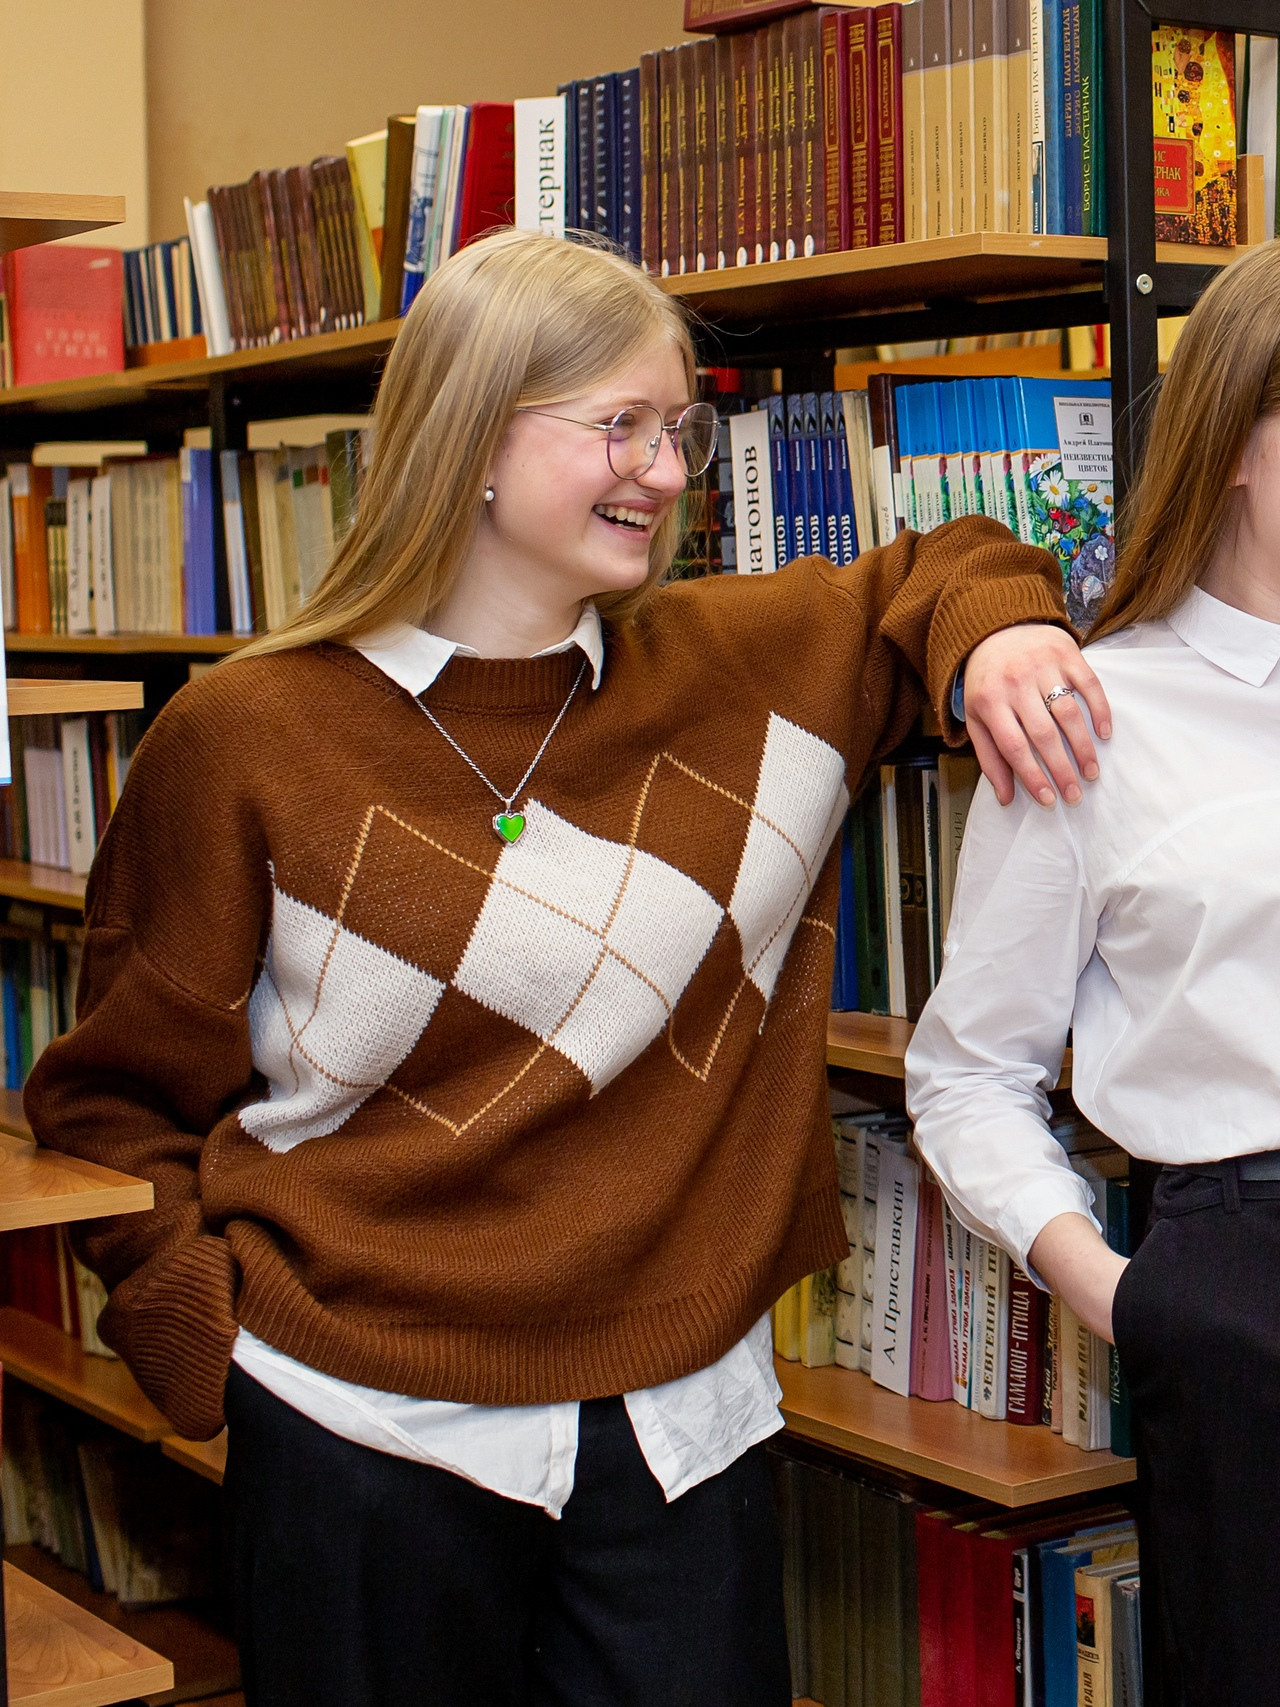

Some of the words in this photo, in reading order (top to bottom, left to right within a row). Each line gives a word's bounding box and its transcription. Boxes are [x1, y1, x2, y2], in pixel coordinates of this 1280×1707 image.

[1030, 5, 1040, 93] ПАСТЕРНАК
[1062, 6, 1071, 87] ПАСТЕРНАК
[1071, 3, 1081, 84] ПАСТЕРНАК
[1081, 75, 1091, 161] ПАСТЕРНАК
[538, 118, 562, 238] тернак
[1083, 163, 1091, 212] БОРИС
[882, 1179, 905, 1366] А.Приставкин
[983, 1285, 997, 1388] ЕВГЕНИЙ
[1008, 1290, 1031, 1415] ГАМАЮН-ПТИЦА
